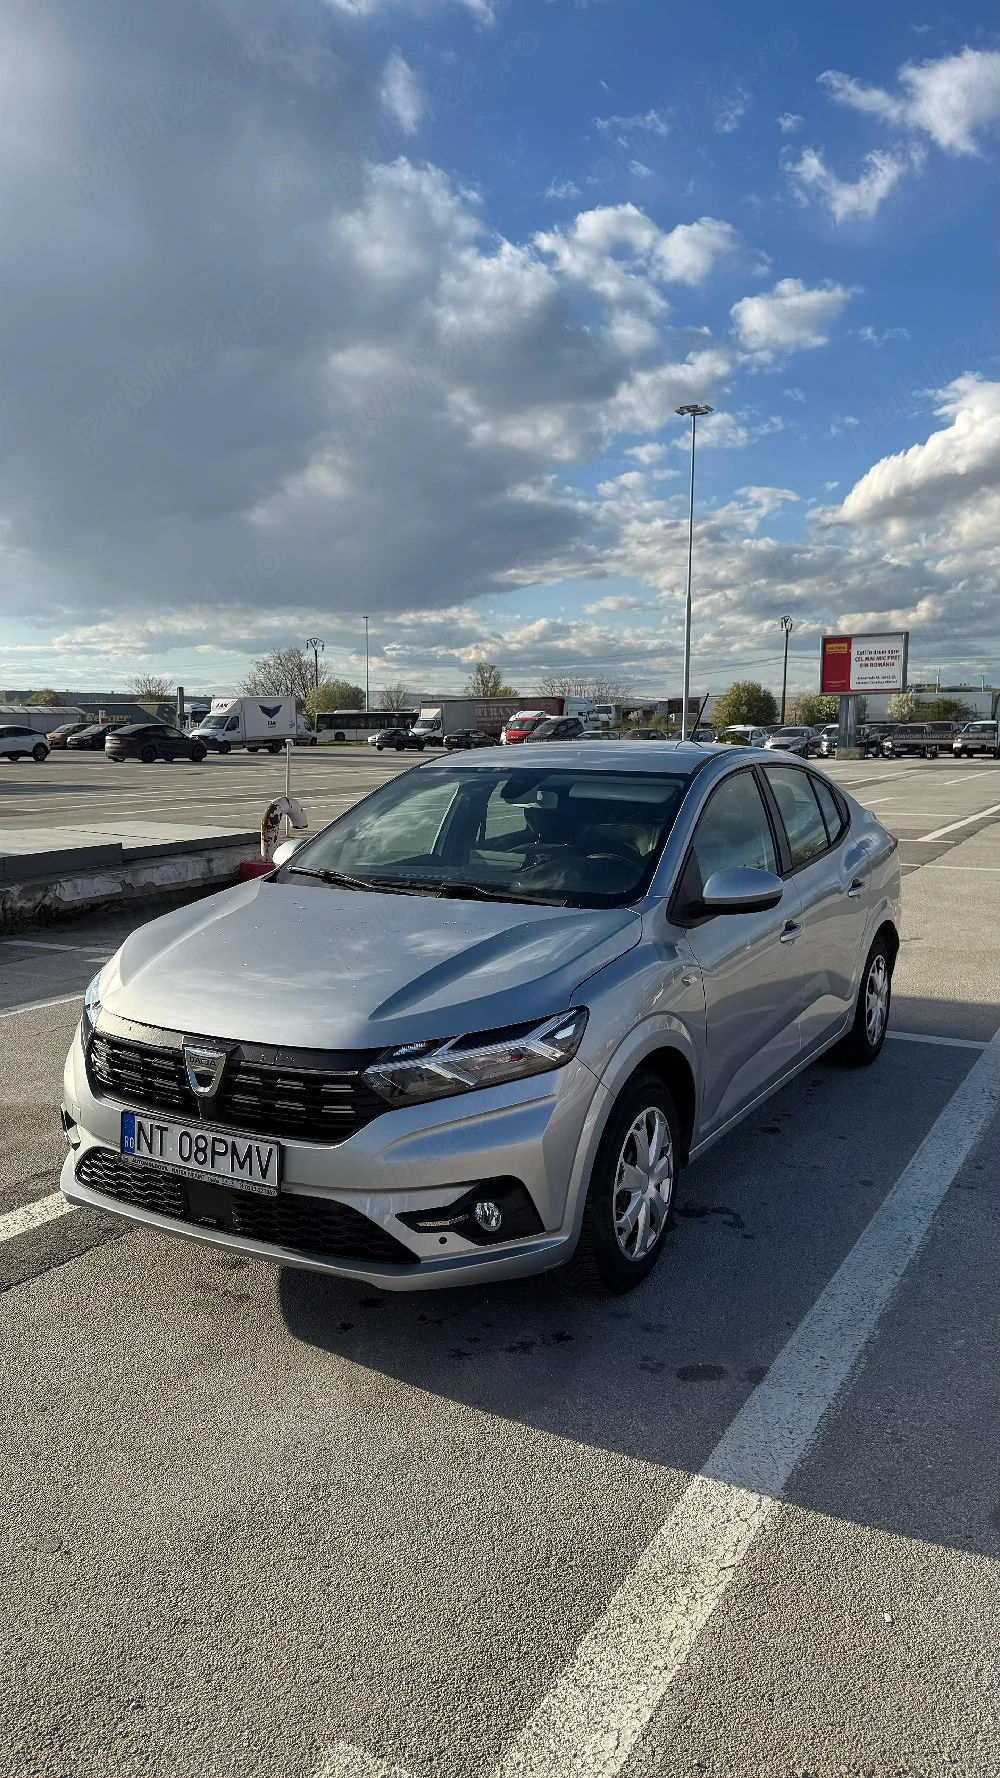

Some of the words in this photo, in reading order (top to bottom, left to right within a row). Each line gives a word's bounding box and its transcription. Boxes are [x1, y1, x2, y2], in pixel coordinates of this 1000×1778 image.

[189, 1056, 217, 1067] DACIA
[124, 1135, 135, 1149] RO
[136, 1120, 168, 1156] NT
